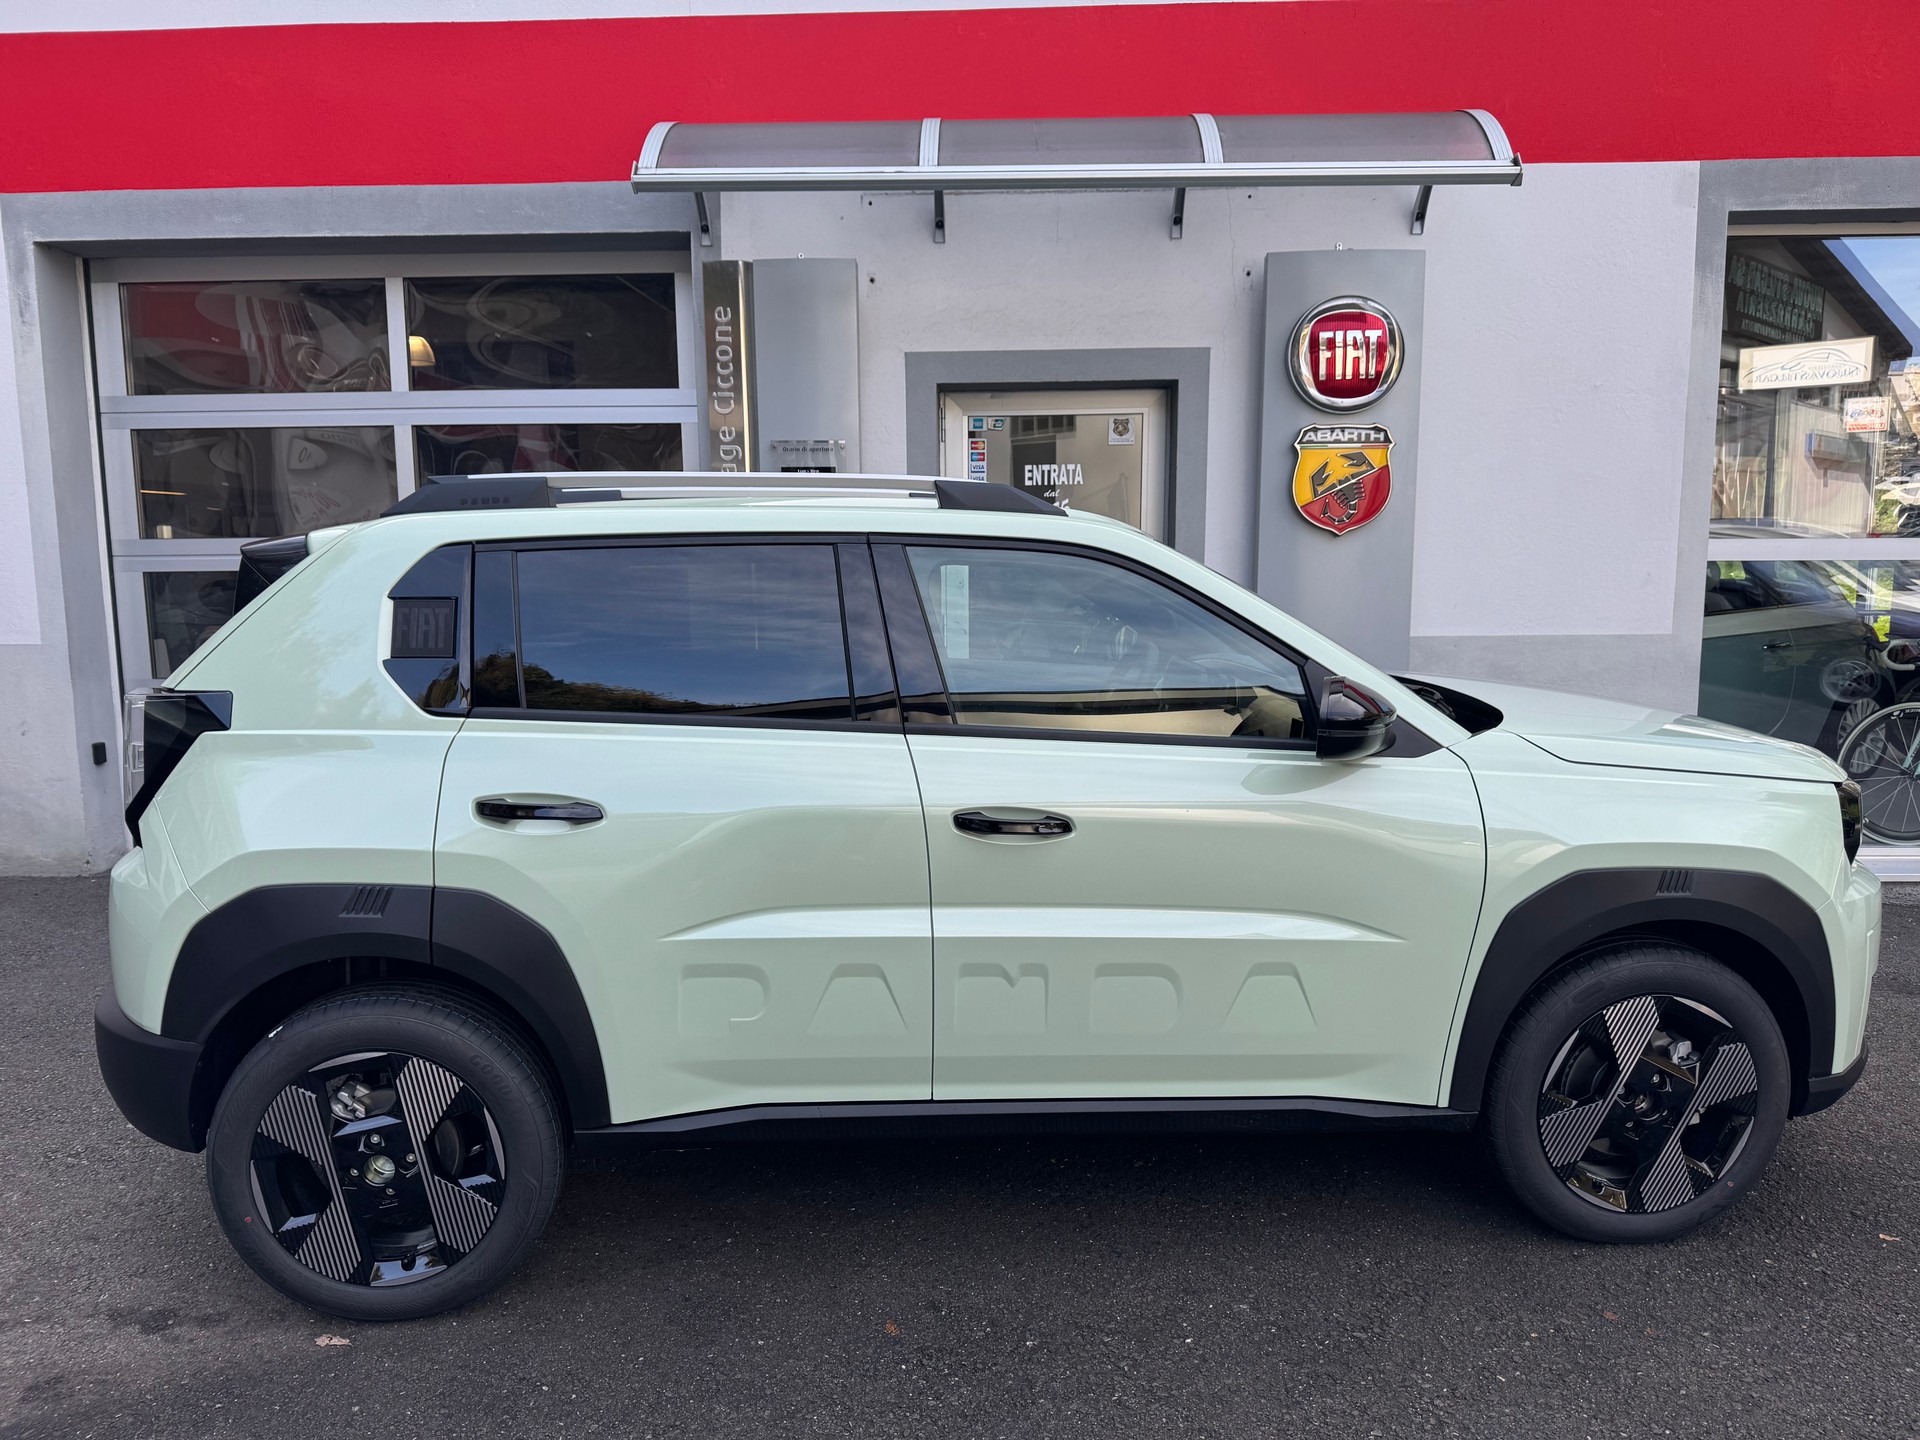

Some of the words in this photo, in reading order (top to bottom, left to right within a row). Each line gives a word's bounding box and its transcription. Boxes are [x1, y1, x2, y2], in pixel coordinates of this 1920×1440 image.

[713, 305, 734, 415] Ciccone
[1318, 328, 1383, 381] FIAT
[719, 425, 742, 473] age
[1302, 428, 1385, 443] ABARTH
[1024, 463, 1084, 486] ENTRATA
[1043, 489, 1061, 498] dal
[460, 496, 512, 506] PANDA
[399, 607, 450, 650] FIAT
[677, 961, 1319, 1037] PANDA
